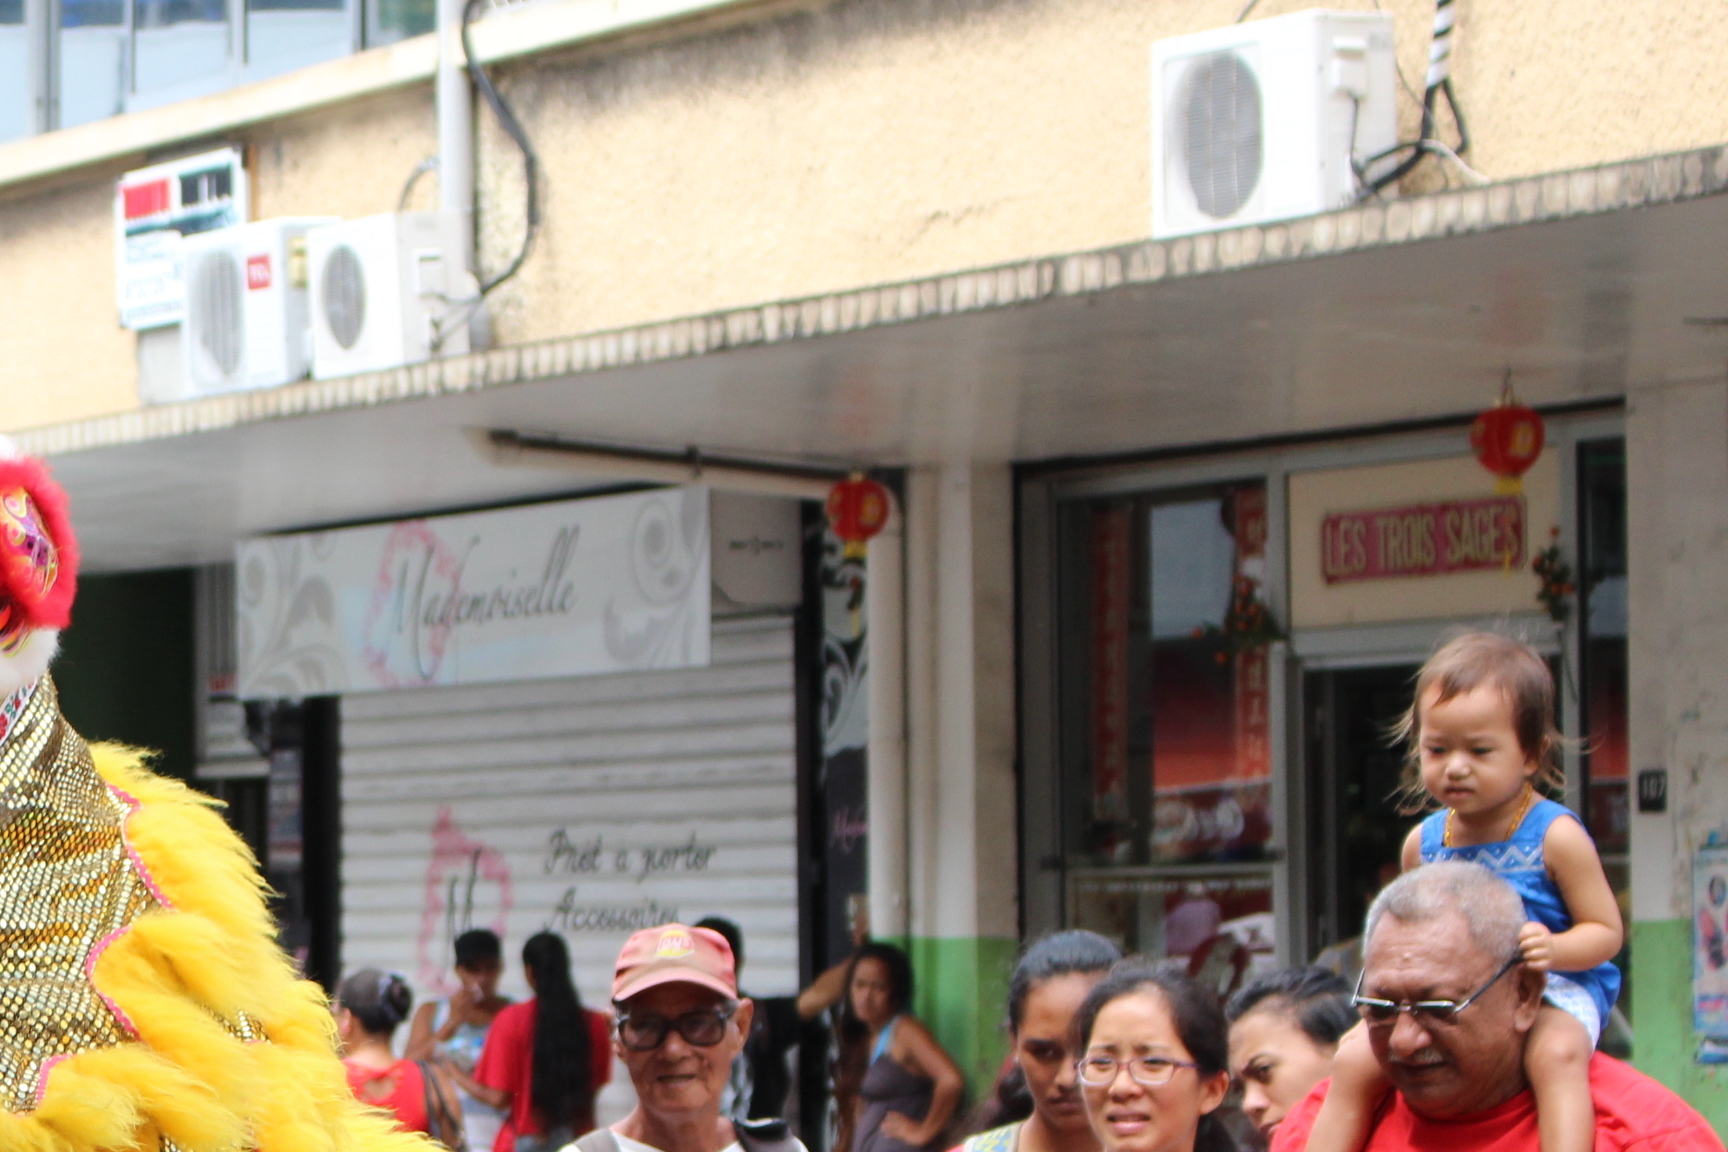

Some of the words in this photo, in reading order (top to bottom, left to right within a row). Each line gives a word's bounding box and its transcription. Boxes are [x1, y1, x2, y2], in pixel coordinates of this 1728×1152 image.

[1323, 517, 1368, 577] LES
[1376, 513, 1438, 572] TROIS
[1444, 503, 1519, 565] SAGES
[395, 522, 581, 681] Mademoiselle
[635, 828, 718, 886] porter
